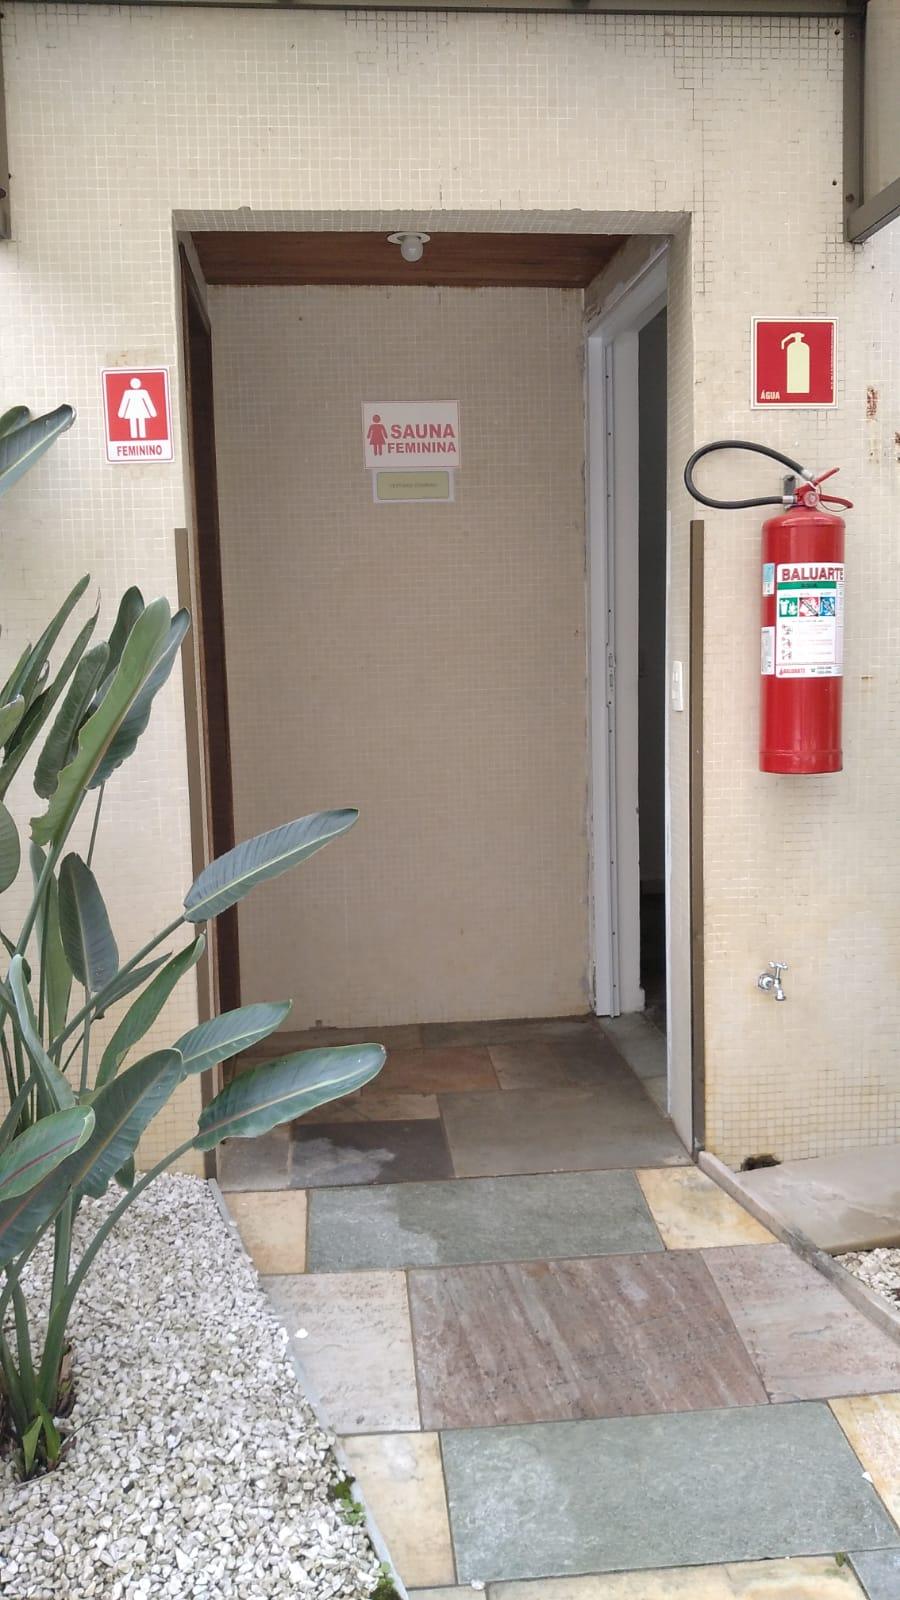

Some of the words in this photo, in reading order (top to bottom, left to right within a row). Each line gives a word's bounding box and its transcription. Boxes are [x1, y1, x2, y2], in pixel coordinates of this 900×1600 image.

[760, 389, 780, 400] ÁGUA
[391, 423, 456, 439] SAUNA
[116, 444, 163, 456] FEMININO
[387, 441, 456, 454] FEMININA
[782, 567, 844, 581] BALUARTE
